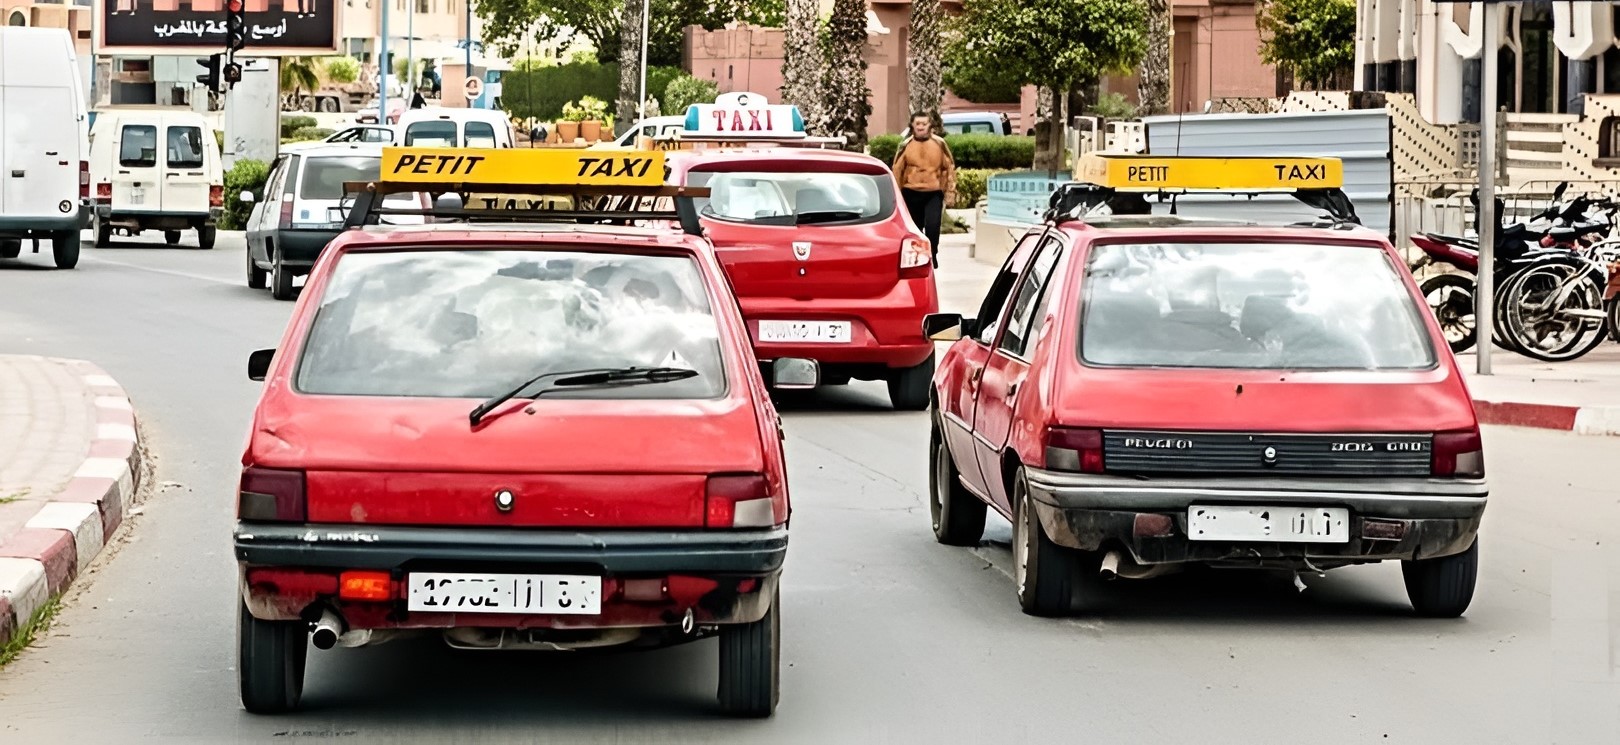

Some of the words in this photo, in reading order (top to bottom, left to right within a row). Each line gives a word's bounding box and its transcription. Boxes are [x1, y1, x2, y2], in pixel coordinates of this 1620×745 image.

[153, 20, 205, 37] بالمغرب
[252, 18, 287, 39] أوسع
[712, 109, 773, 132] TAXI
[393, 154, 486, 175] PETIT
[577, 157, 653, 178] TAXI
[1128, 165, 1170, 182] PETIT
[1273, 164, 1326, 181] TAXI
